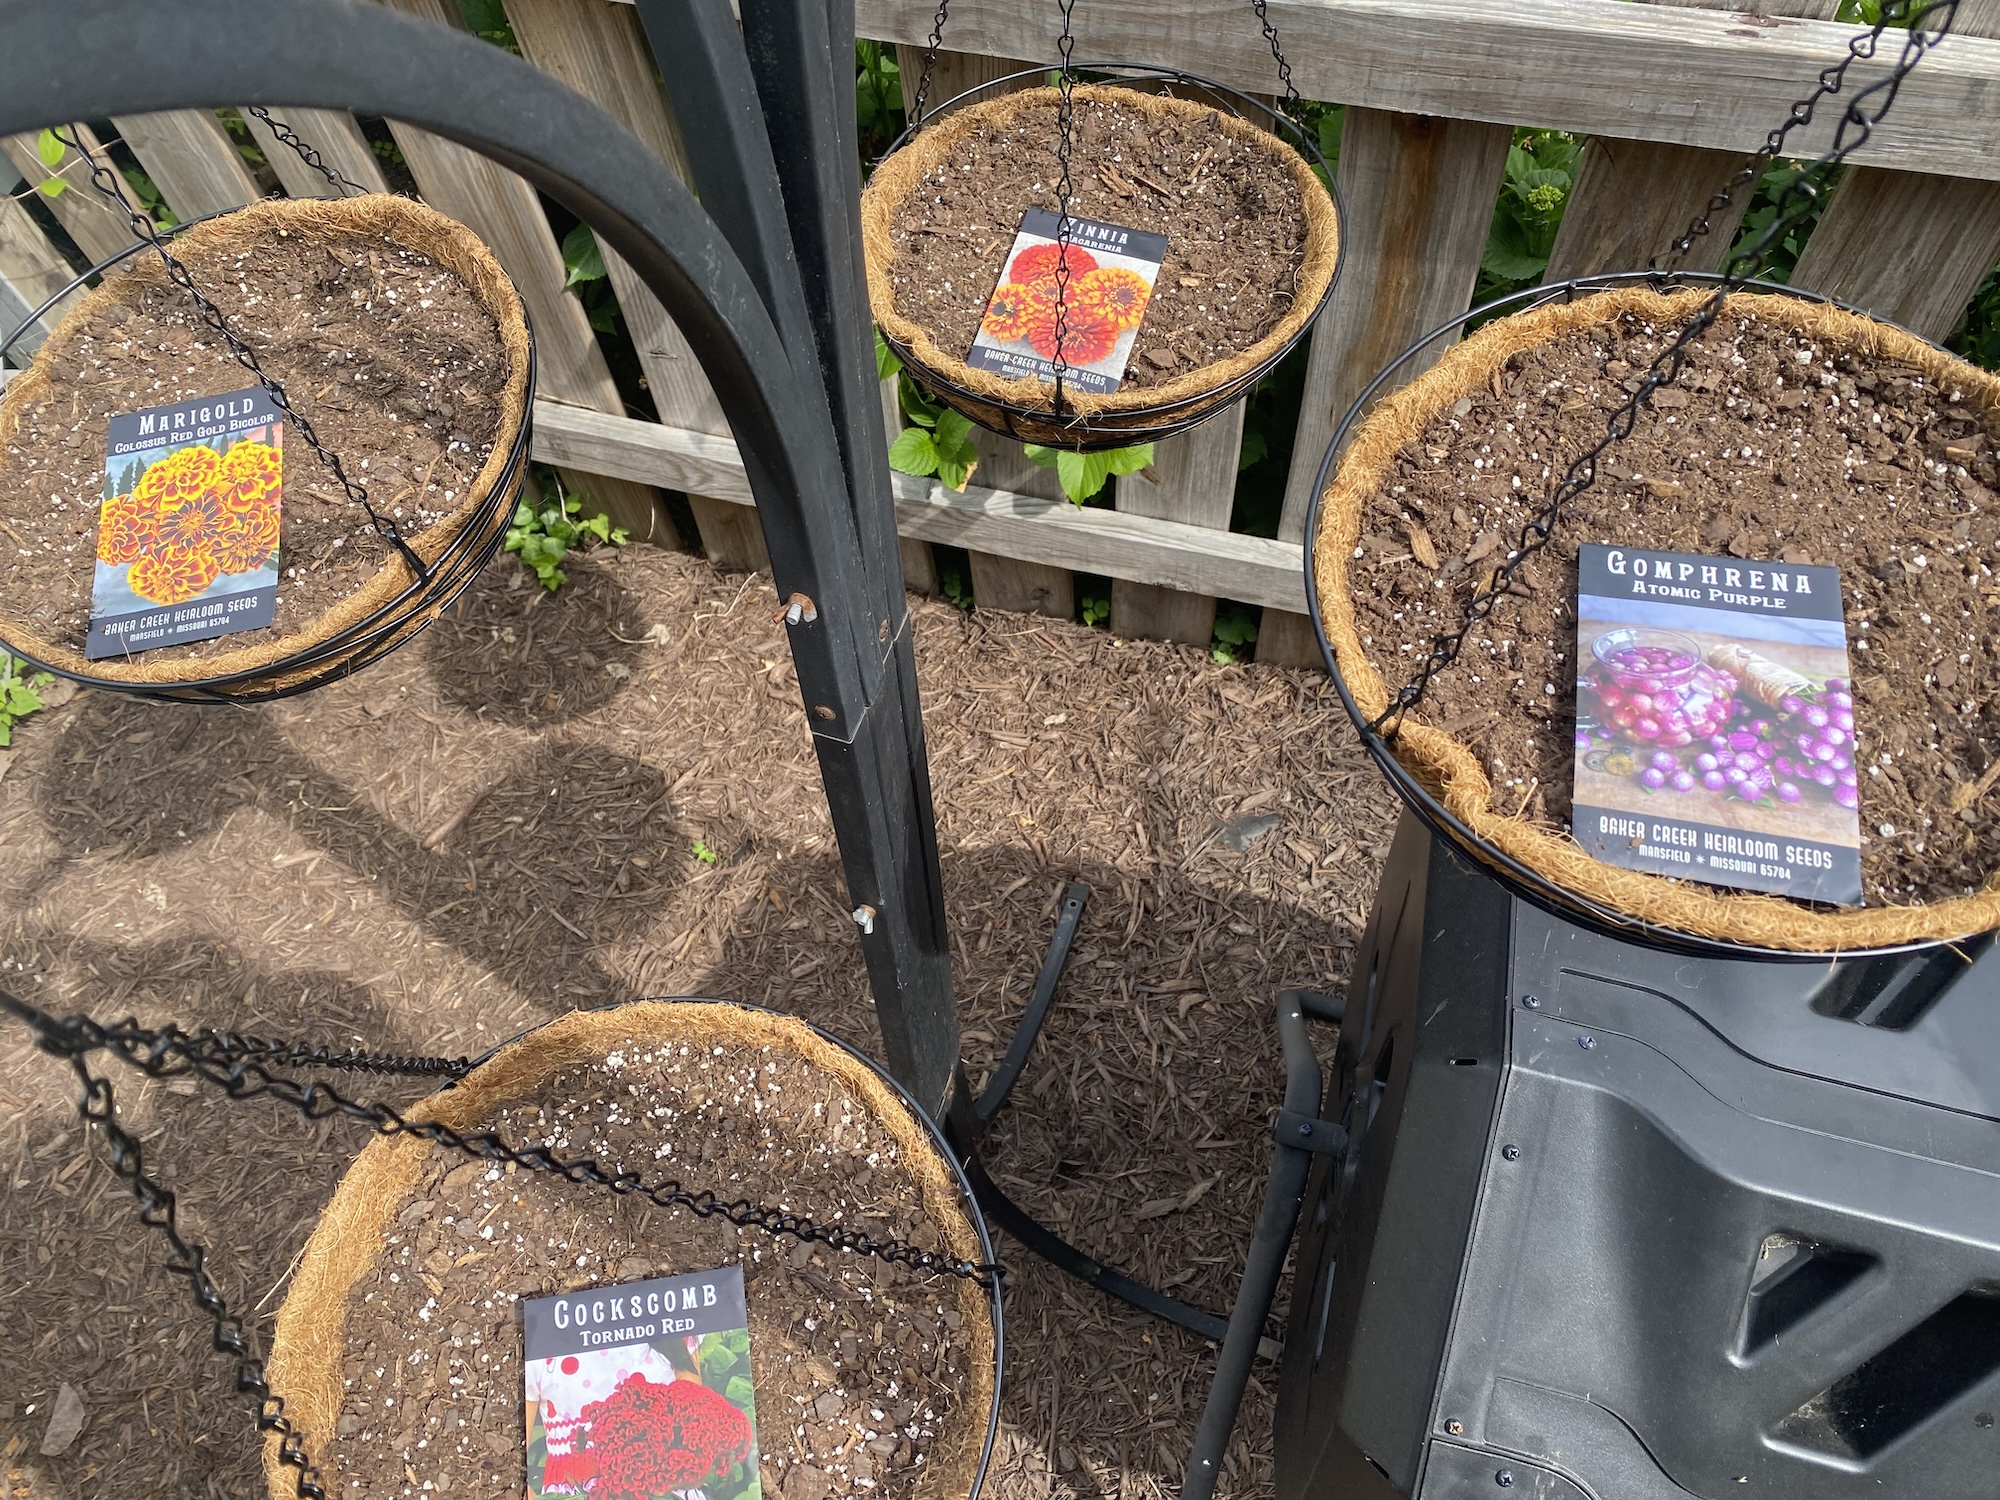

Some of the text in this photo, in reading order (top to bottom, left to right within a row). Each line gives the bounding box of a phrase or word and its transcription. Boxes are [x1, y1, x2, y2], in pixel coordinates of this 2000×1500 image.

[984, 349, 1106, 386] BAKER CREEK HEIROM SEEDS
[115, 413, 274, 453] COLOSSUS RED GOLD BICOLOR
[138, 398, 254, 435] MARIGOLD
[1607, 550, 1812, 594] GOMPHRENA
[1632, 580, 1787, 609] ATOMIC PURPLE
[104, 596, 258, 635] BAKER CREEK HEIRLOOM SEEDS
[130, 616, 229, 642] MANSFIELD MISSOURI 65704
[1599, 816, 1833, 869] BAKER CREEK HEIRLOOM SEEDS
[1639, 844, 1792, 880] MANSFIELD MISSOURI 65704
[554, 1284, 717, 1330] COCKSCOMB
[579, 1317, 696, 1347] TORNADO RED
